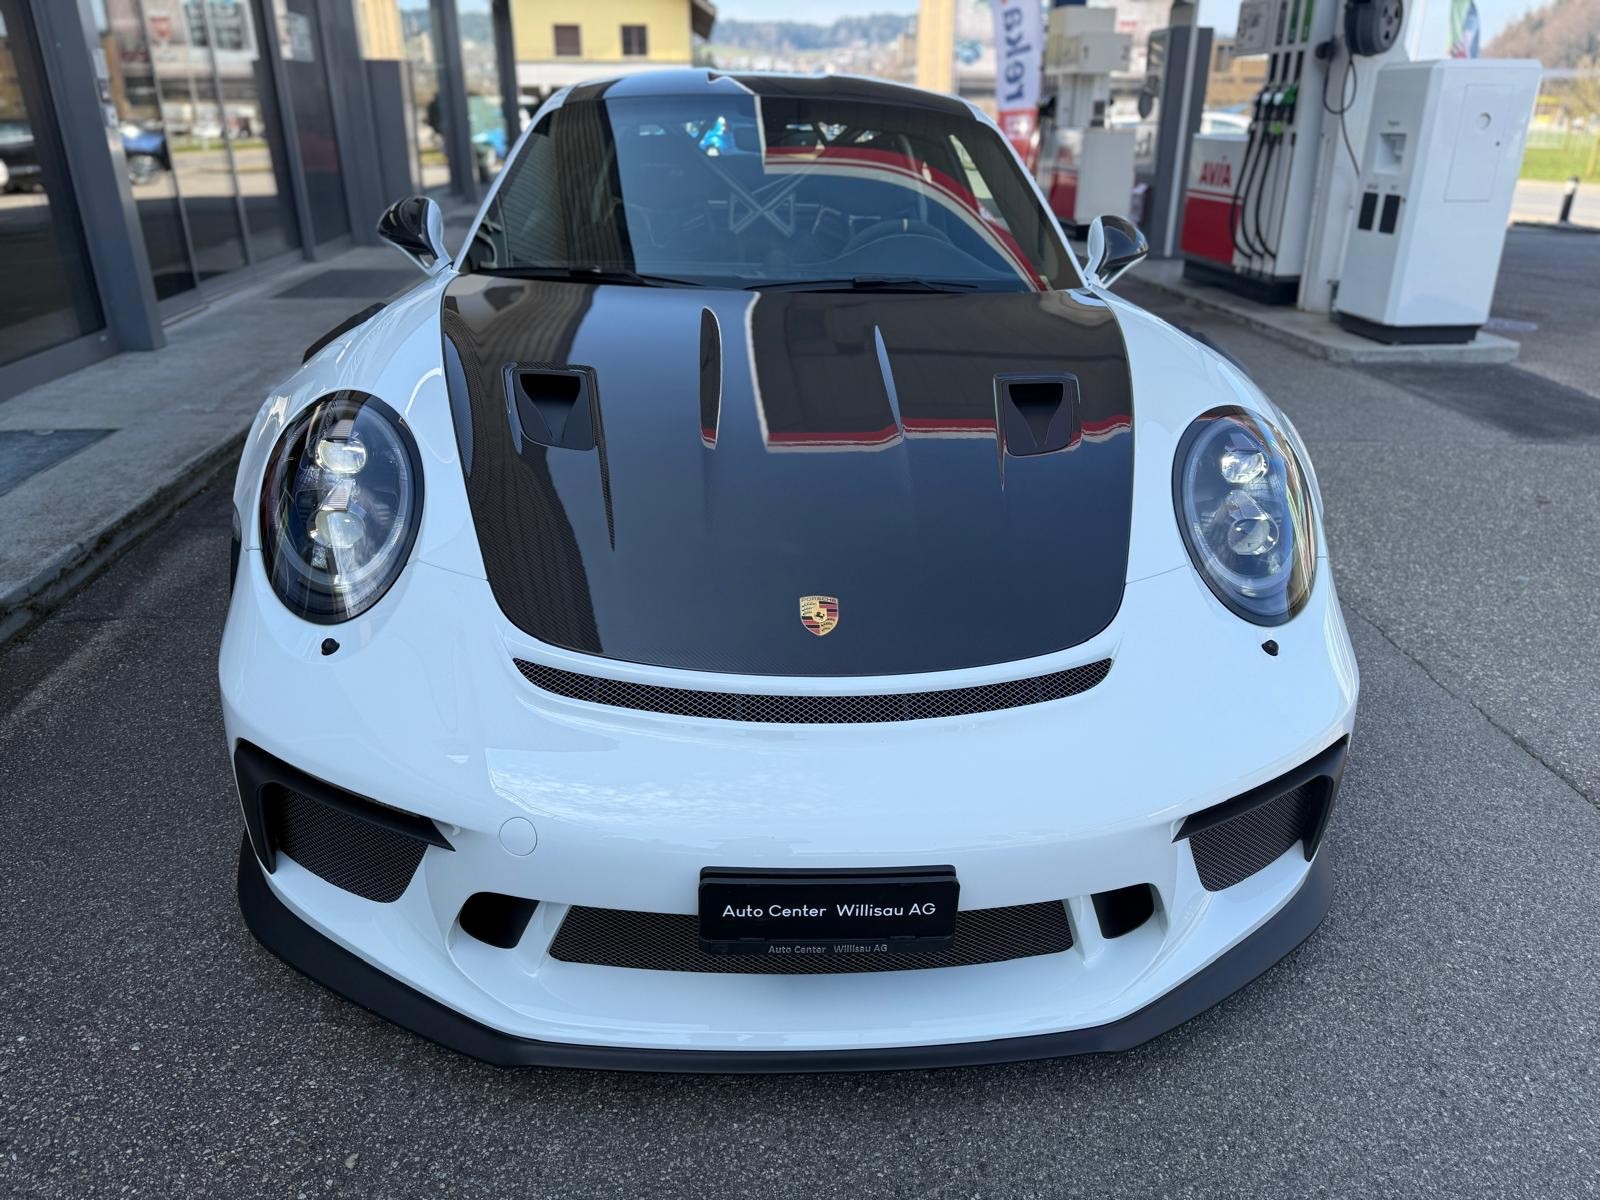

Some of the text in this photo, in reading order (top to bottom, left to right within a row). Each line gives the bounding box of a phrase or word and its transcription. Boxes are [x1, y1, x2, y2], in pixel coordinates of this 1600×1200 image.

[1199, 158, 1232, 188] AVIA
[722, 902, 936, 917] Auto Center Willisau AG
[768, 944, 888, 954] Auto Center Willisau AG
